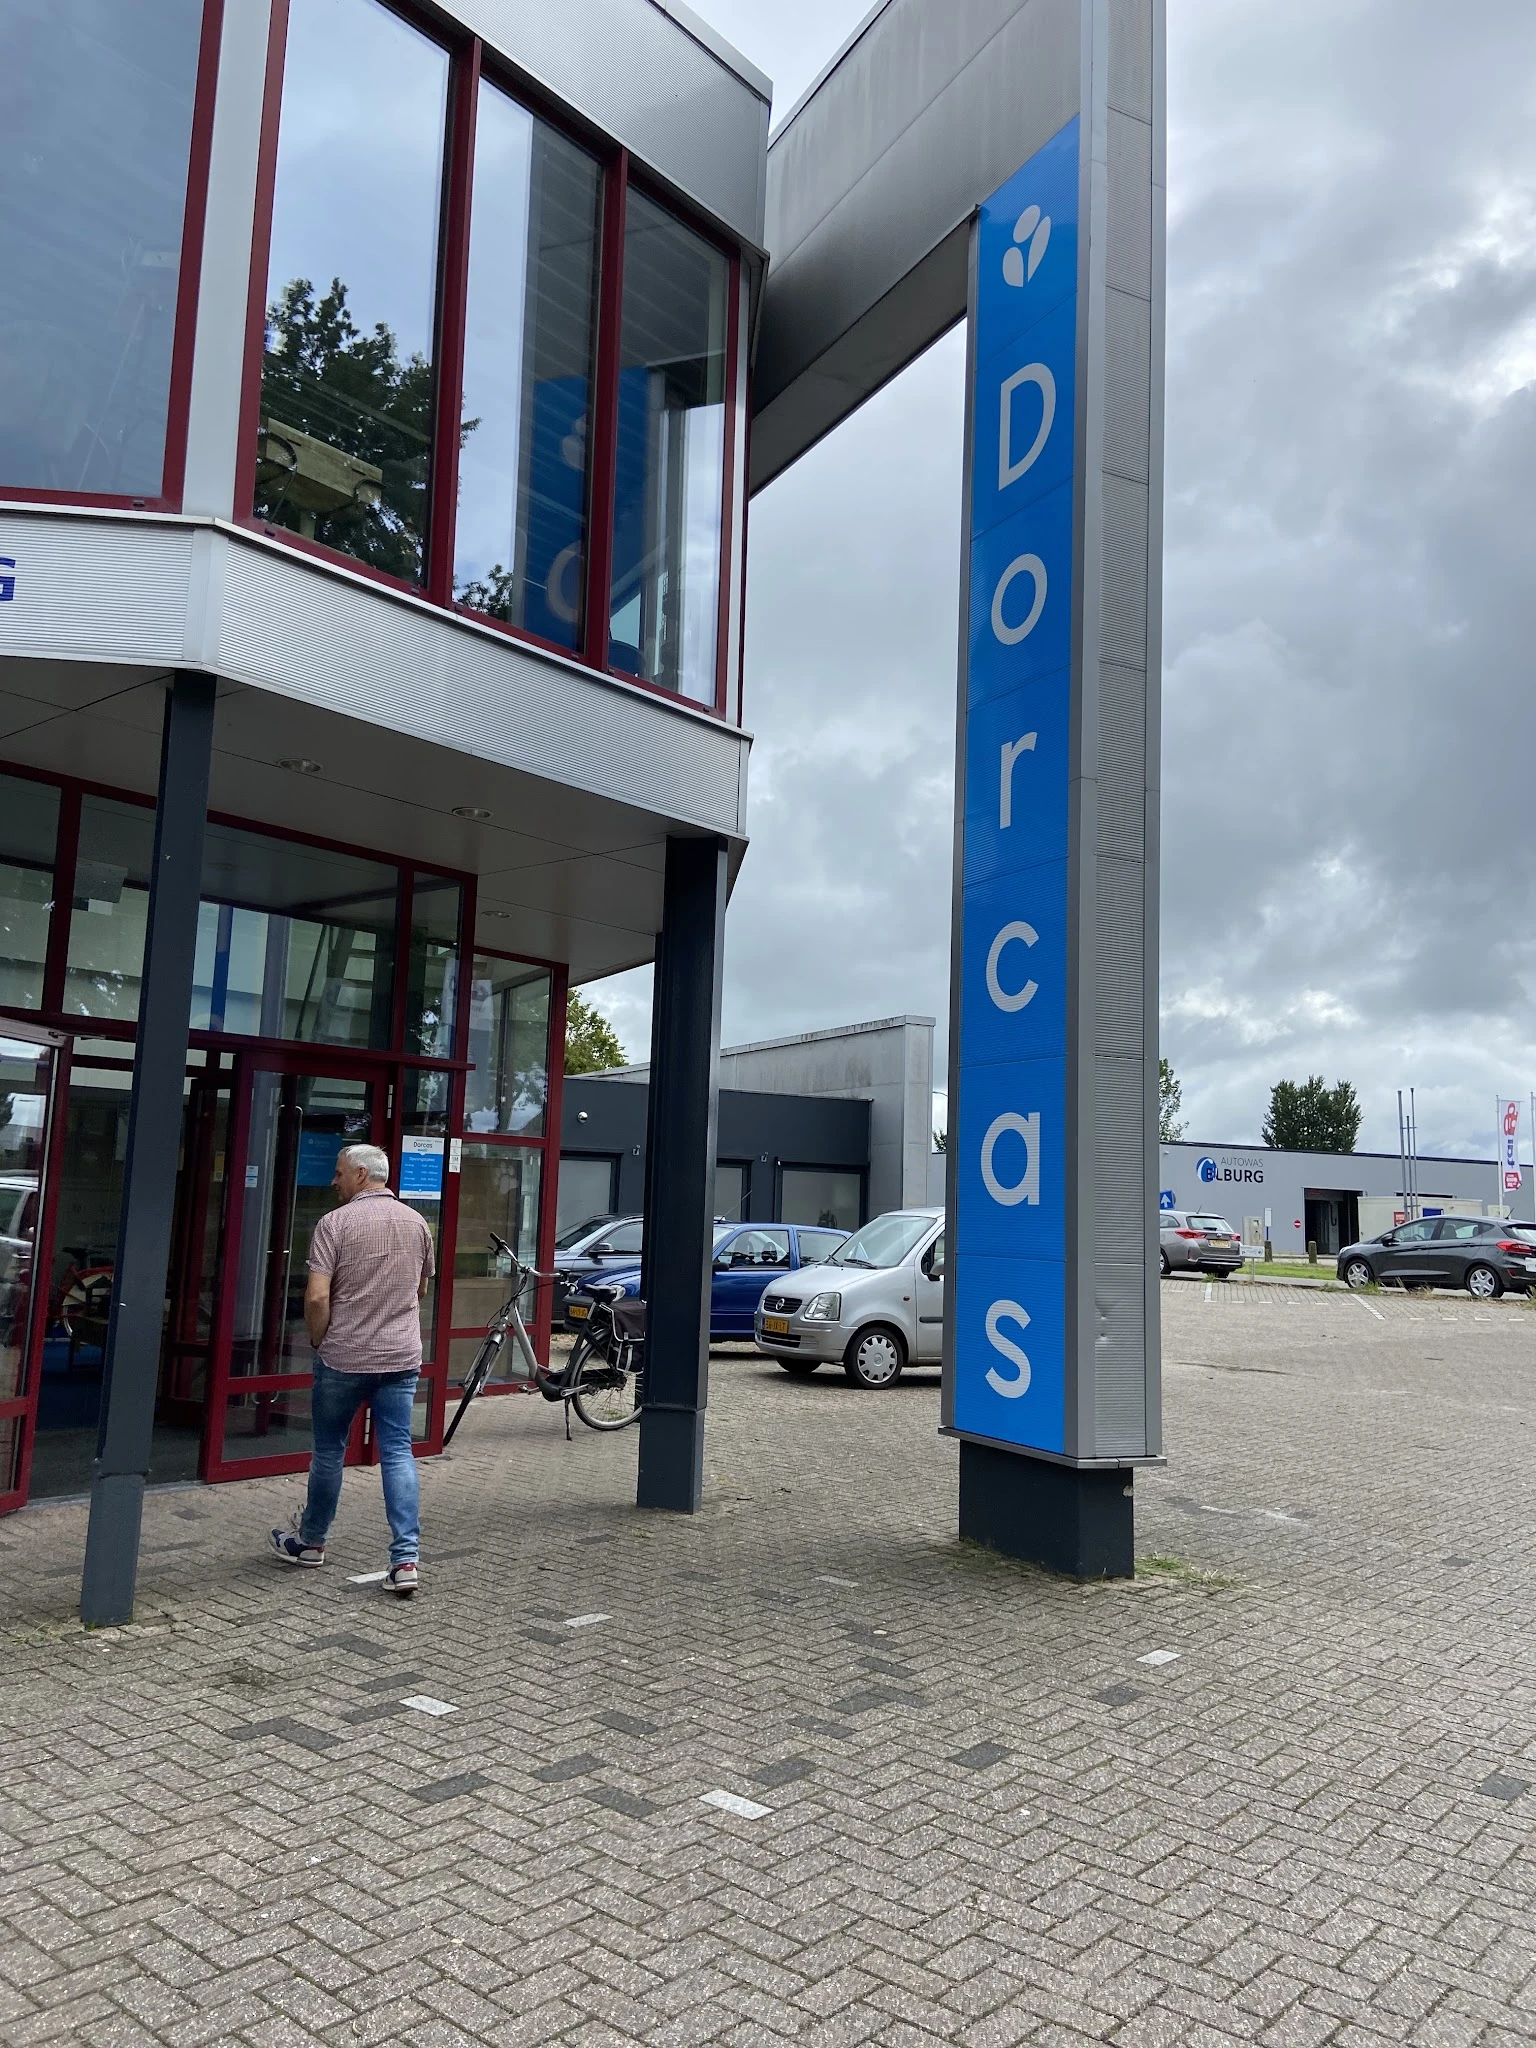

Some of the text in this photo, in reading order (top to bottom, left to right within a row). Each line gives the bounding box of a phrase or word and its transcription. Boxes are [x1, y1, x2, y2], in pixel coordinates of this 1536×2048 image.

[979, 362, 1057, 1400] Dorcas
[413, 1141, 433, 1149] Dorcas
[1220, 1156, 1264, 1168] AUTOWAS
[1206, 1167, 1264, 1183] ELBURG
